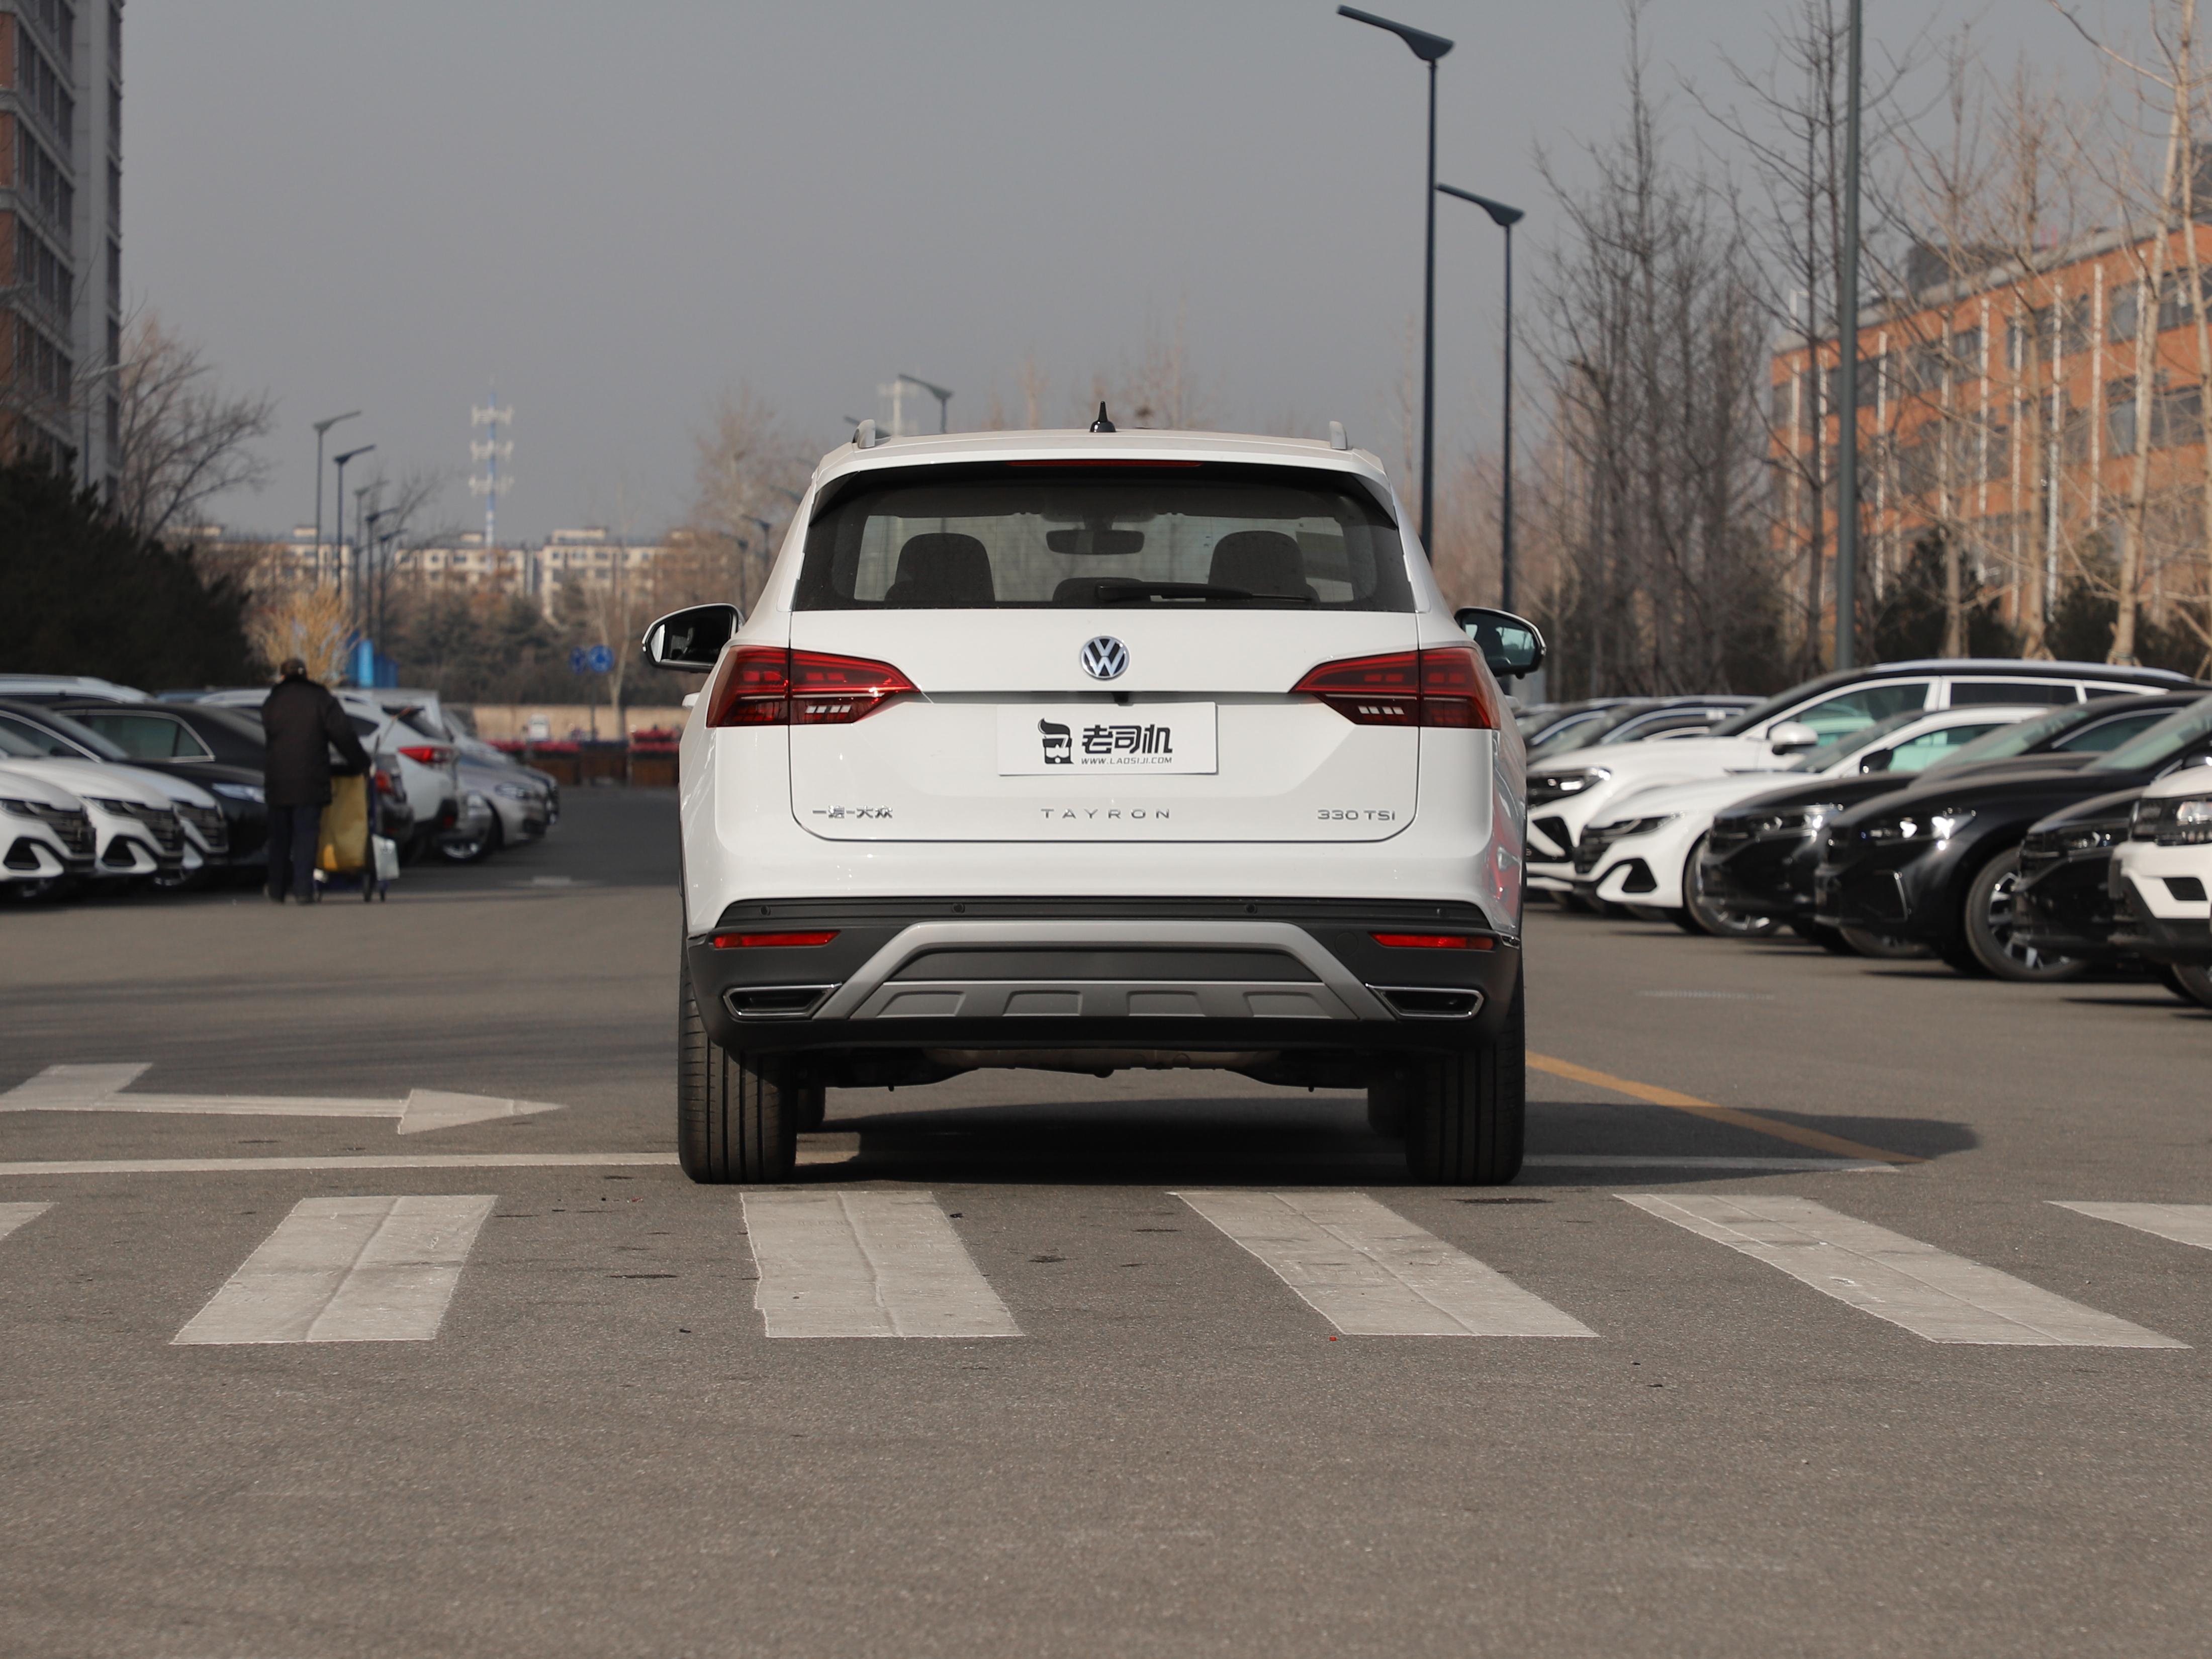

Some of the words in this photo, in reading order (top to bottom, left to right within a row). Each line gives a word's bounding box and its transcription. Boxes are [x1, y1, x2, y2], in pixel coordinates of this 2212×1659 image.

[1081, 636, 1129, 680] VW
[1081, 724, 1173, 754] 老司机
[1081, 757, 1172, 765] WWW.LAOSIJI.COM
[1040, 808, 1170, 819] TAYRON
[1317, 809, 1359, 820] 330
[1363, 810, 1396, 821] TSI
